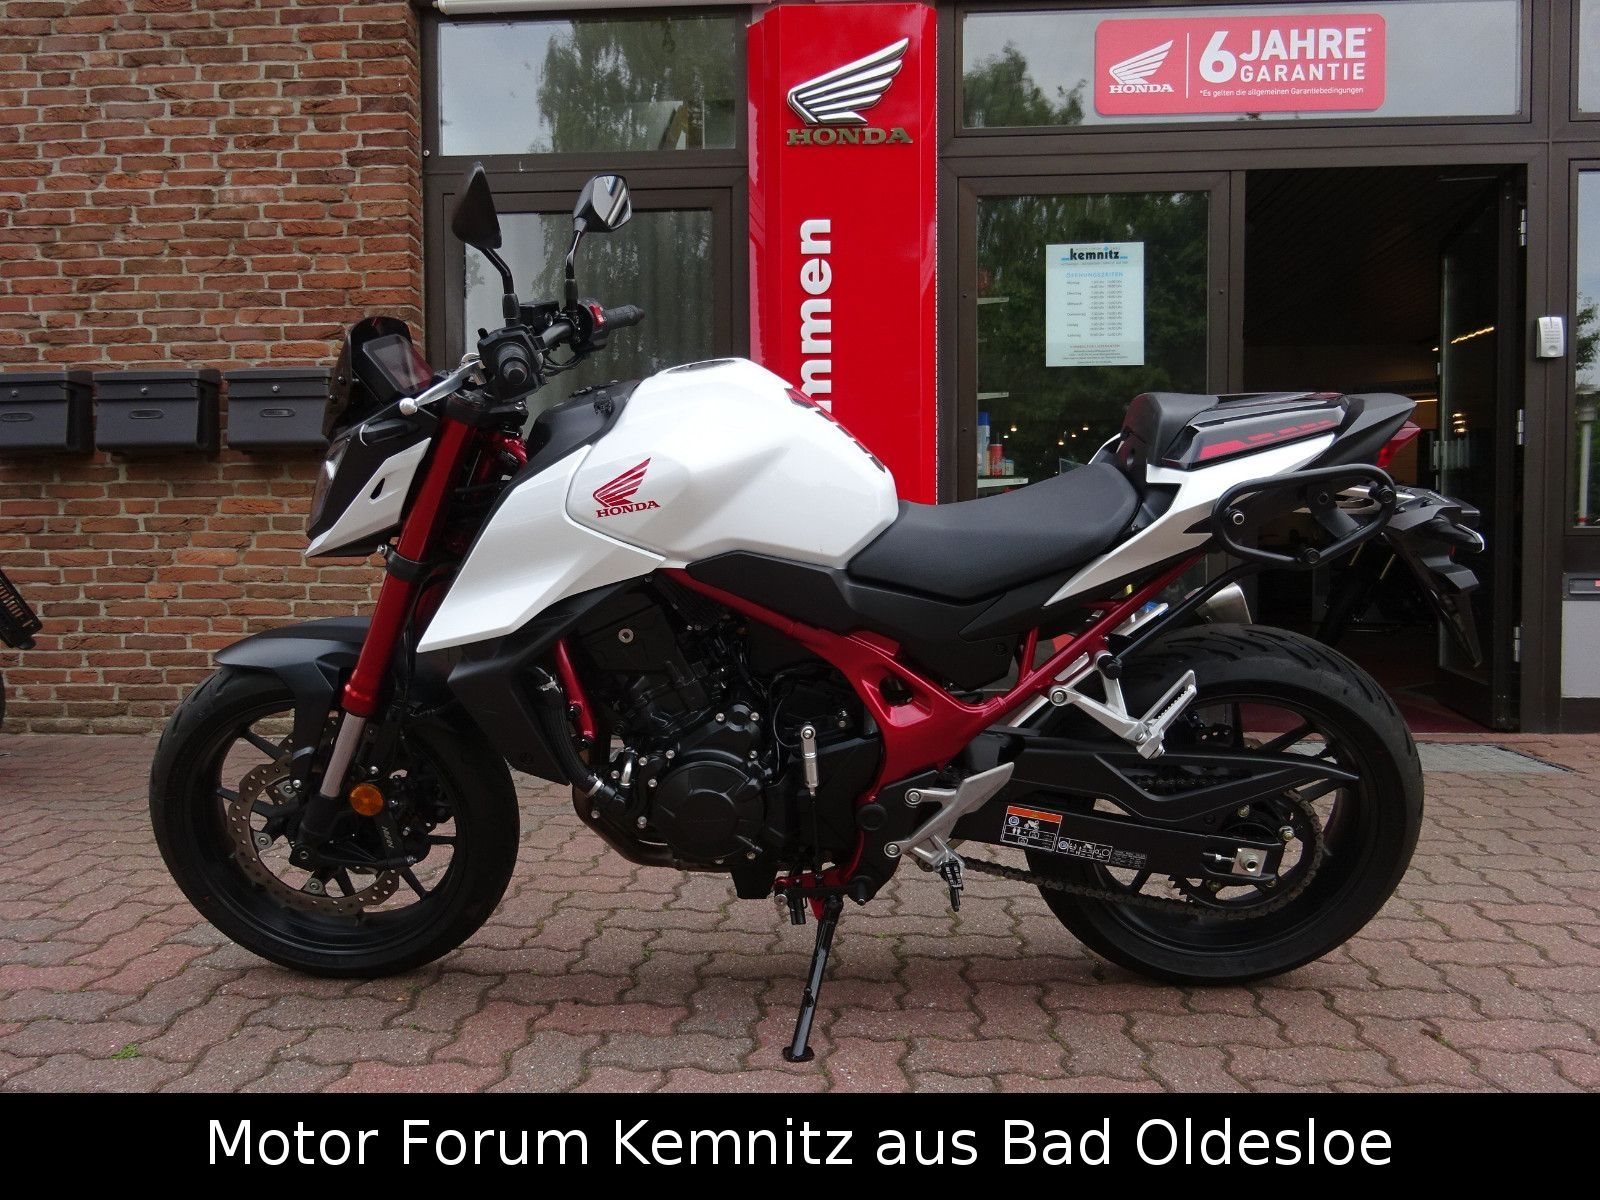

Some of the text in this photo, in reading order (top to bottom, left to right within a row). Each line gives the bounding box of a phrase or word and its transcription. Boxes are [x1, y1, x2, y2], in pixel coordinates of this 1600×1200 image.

[1199, 30, 1237, 83] 6
[1240, 62, 1366, 83] GARANTIE
[1108, 83, 1175, 95] HONDA
[1212, 89, 1235, 98] gelten
[1235, 88, 1246, 96] die
[1247, 87, 1290, 97] allgemeinen
[1290, 86, 1364, 96] Garantiebedingungen
[786, 127, 914, 147] HONDA
[1070, 246, 1120, 261] kemnitz
[595, 500, 661, 519] HONDA
